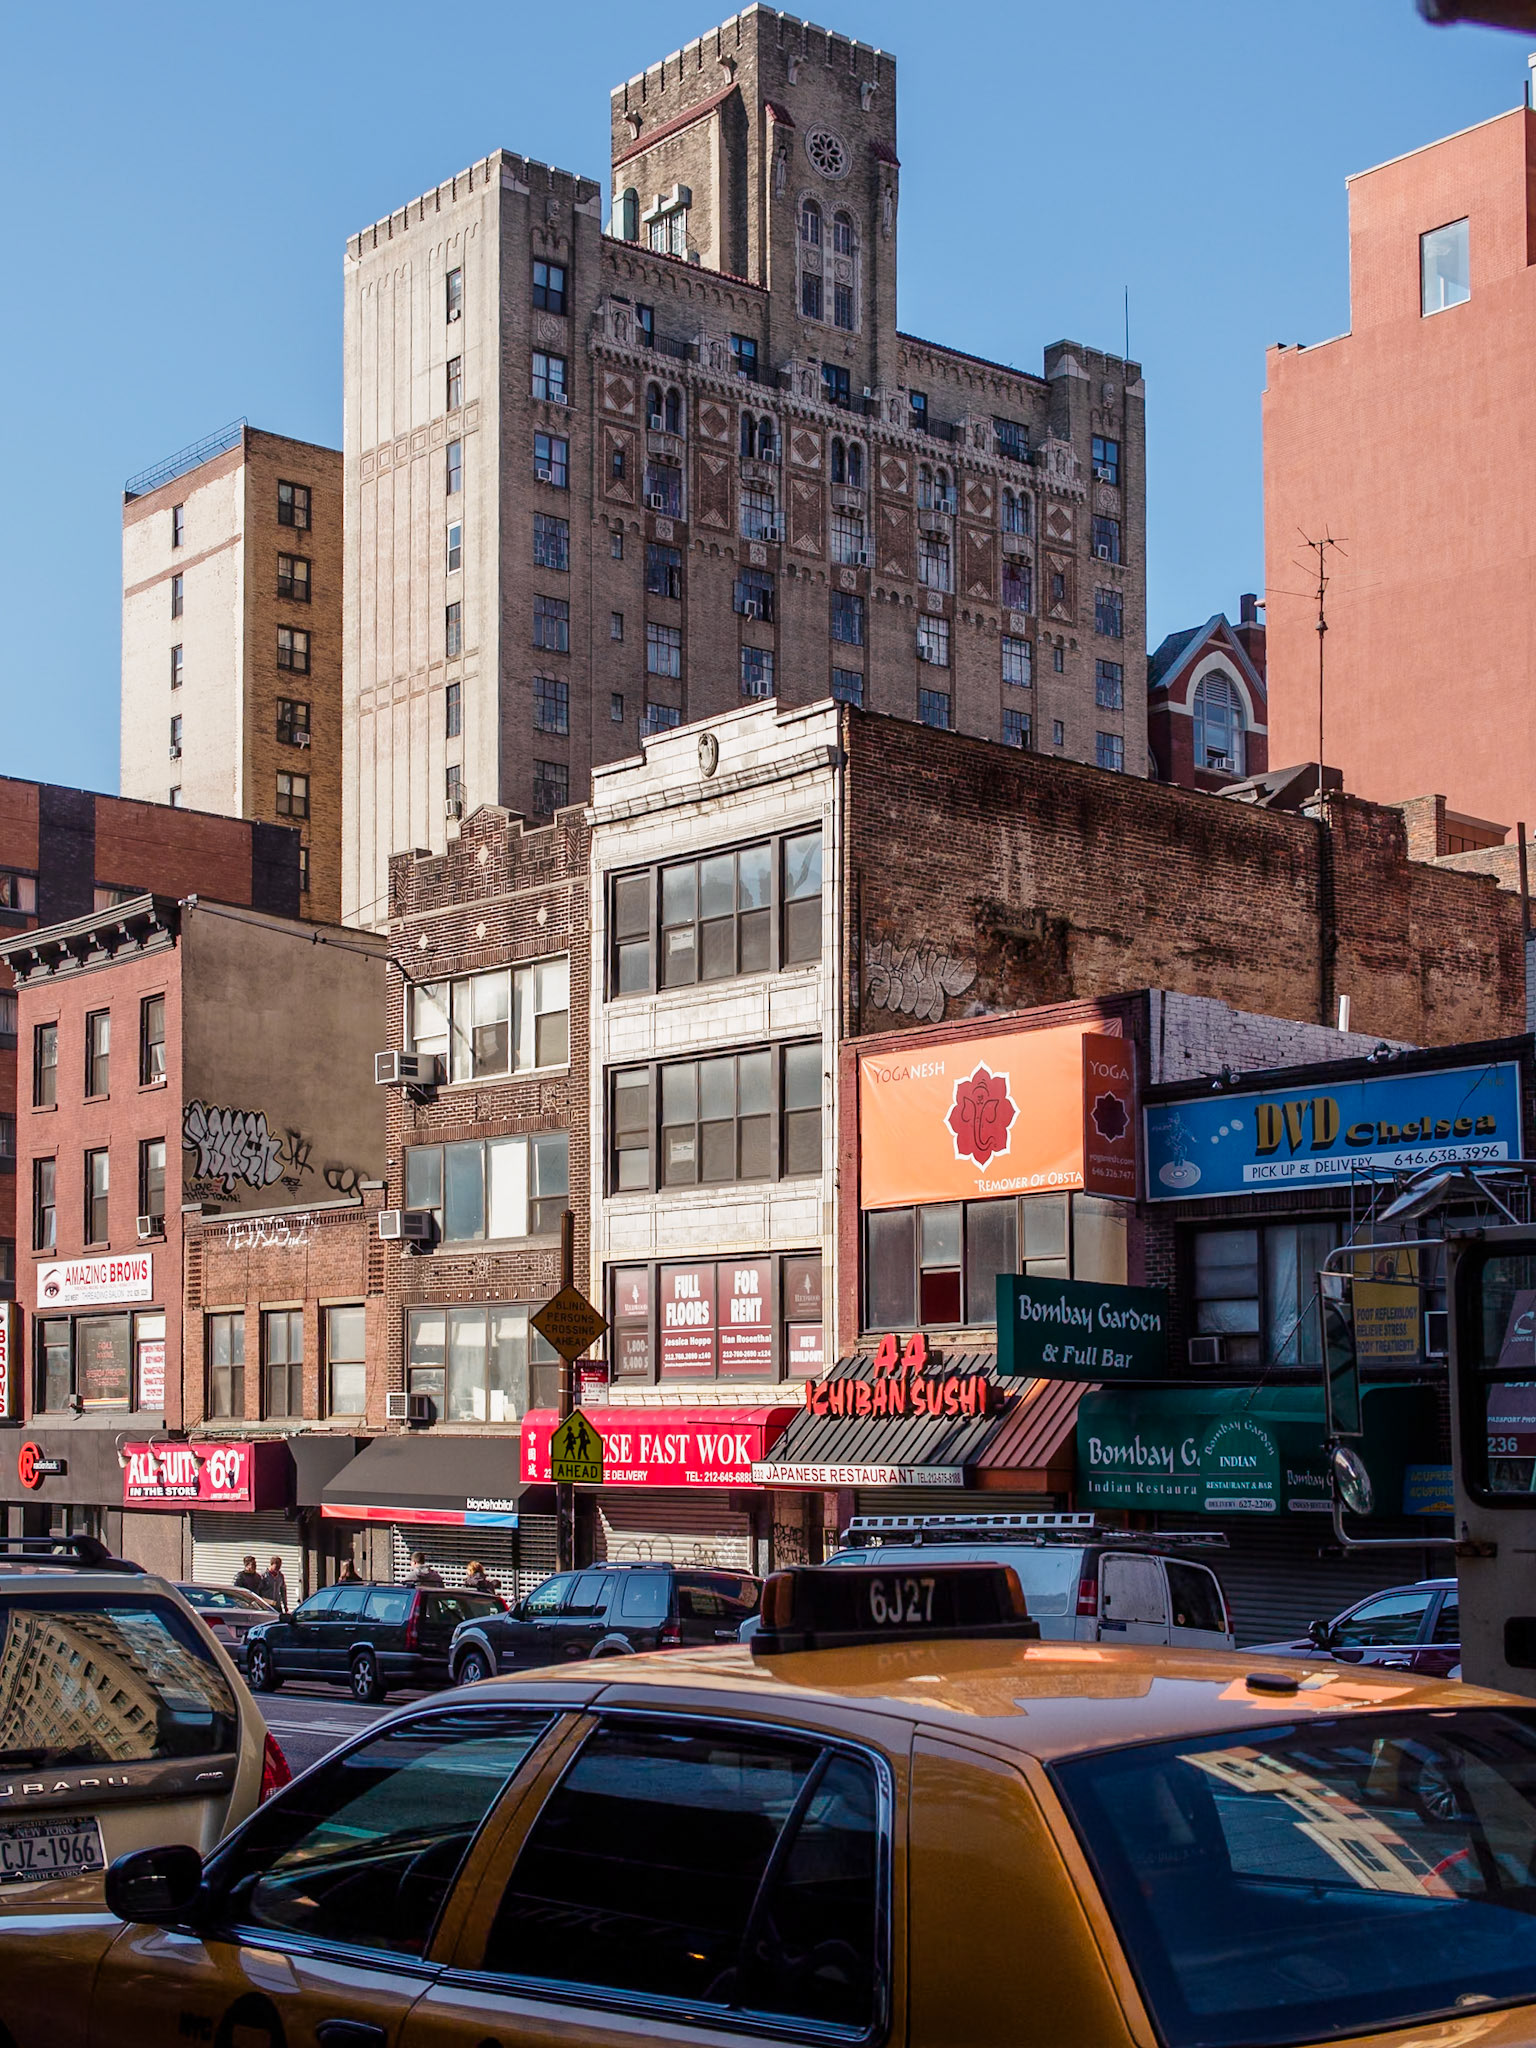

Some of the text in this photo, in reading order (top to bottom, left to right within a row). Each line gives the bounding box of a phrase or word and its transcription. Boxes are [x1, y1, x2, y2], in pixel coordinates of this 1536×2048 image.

[873, 1061, 945, 1083] YOGANESH
[1089, 1060, 1130, 1081] YOGA
[1255, 1097, 1340, 1157] DVD
[1252, 1144, 1500, 1178] PICK UP & DELIVERY 646.638.3996
[1046, 1172, 1083, 1186] OBSTA
[65, 1260, 148, 1286] AMAZING BROWS
[734, 1269, 759, 1295] FOR
[675, 1274, 701, 1299] FULL
[556, 1301, 586, 1311] BLIND
[666, 1301, 710, 1327] FLOORS
[730, 1297, 762, 1323] RENT
[1018, 1294, 1162, 1334] Bombay Garden
[547, 1311, 595, 1324] PERSONS
[545, 1323, 596, 1336] CROSSING
[737, 1333, 772, 1344] Rosenthal
[1384, 1322, 1408, 1336] STRESS
[555, 1336, 587, 1347] AHEAD
[665, 1336, 712, 1347] Jessica Hoppe
[800, 1335, 816, 1347] NEW
[874, 1333, 929, 1379] AA
[1042, 1343, 1133, 1369] & Full Bar
[805, 1374, 988, 1418] ICHIBAN SUSHI
[1204, 1419, 1275, 1456] Bombay Garden
[1488, 1437, 1518, 1452] 236
[640, 1433, 691, 1464] FAST
[697, 1433, 753, 1465] WOK
[1088, 1435, 1200, 1474] Bombay G
[128, 1453, 158, 1484] ALL
[160, 1451, 199, 1484] SUITS
[557, 1463, 599, 1480] AHEAD
[1219, 1455, 1257, 1468] INDIAN
[612, 1470, 648, 1482] DELIVERY
[685, 1471, 704, 1483] TEL:
[766, 1466, 827, 1482] JAPANESE
[830, 1467, 915, 1484] RESTAURANT
[1206, 1480, 1273, 1490] RESTAURANT & BAR
[1287, 1470, 1325, 1491] Bombay
[130, 1486, 198, 1497] IN THE STORE
[1088, 1480, 1131, 1493] Indian
[466, 1497, 514, 1511] bicycle habitat
[869, 1578, 936, 1624] 6J27
[0, 1776, 129, 1797] UBARU
[16, 1826, 74, 1839] NEW YORK
[49, 1835, 95, 1866] 1966
